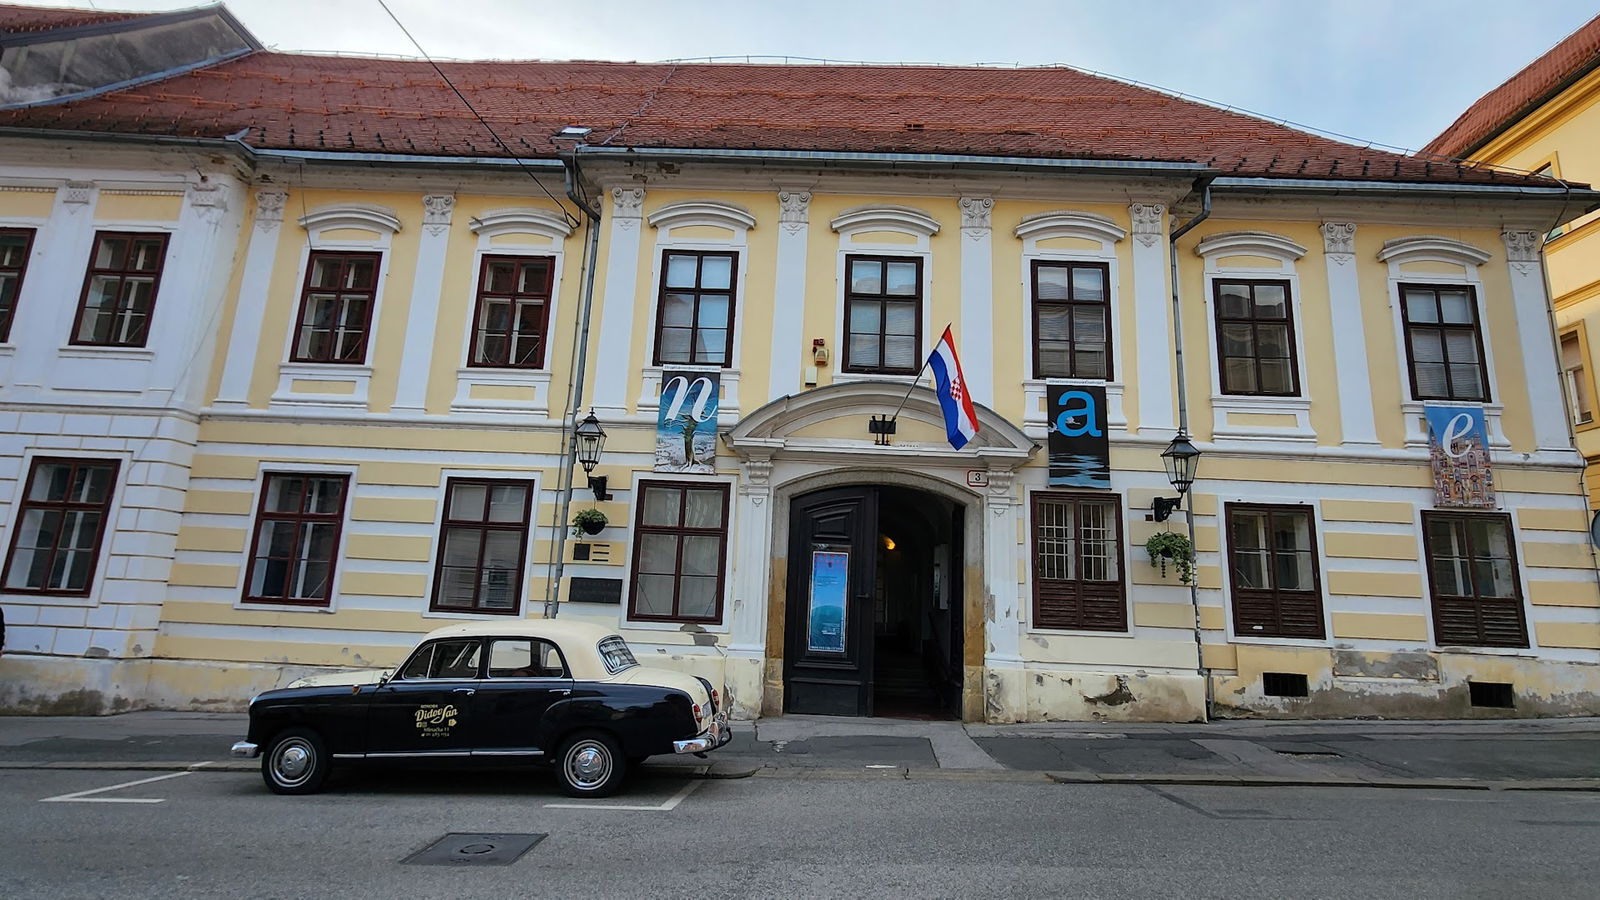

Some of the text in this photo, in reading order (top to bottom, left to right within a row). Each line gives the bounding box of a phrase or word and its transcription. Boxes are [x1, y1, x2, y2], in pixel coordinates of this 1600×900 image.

[1057, 391, 1102, 437] a
[1443, 413, 1474, 457] e
[975, 473, 981, 481] 3
